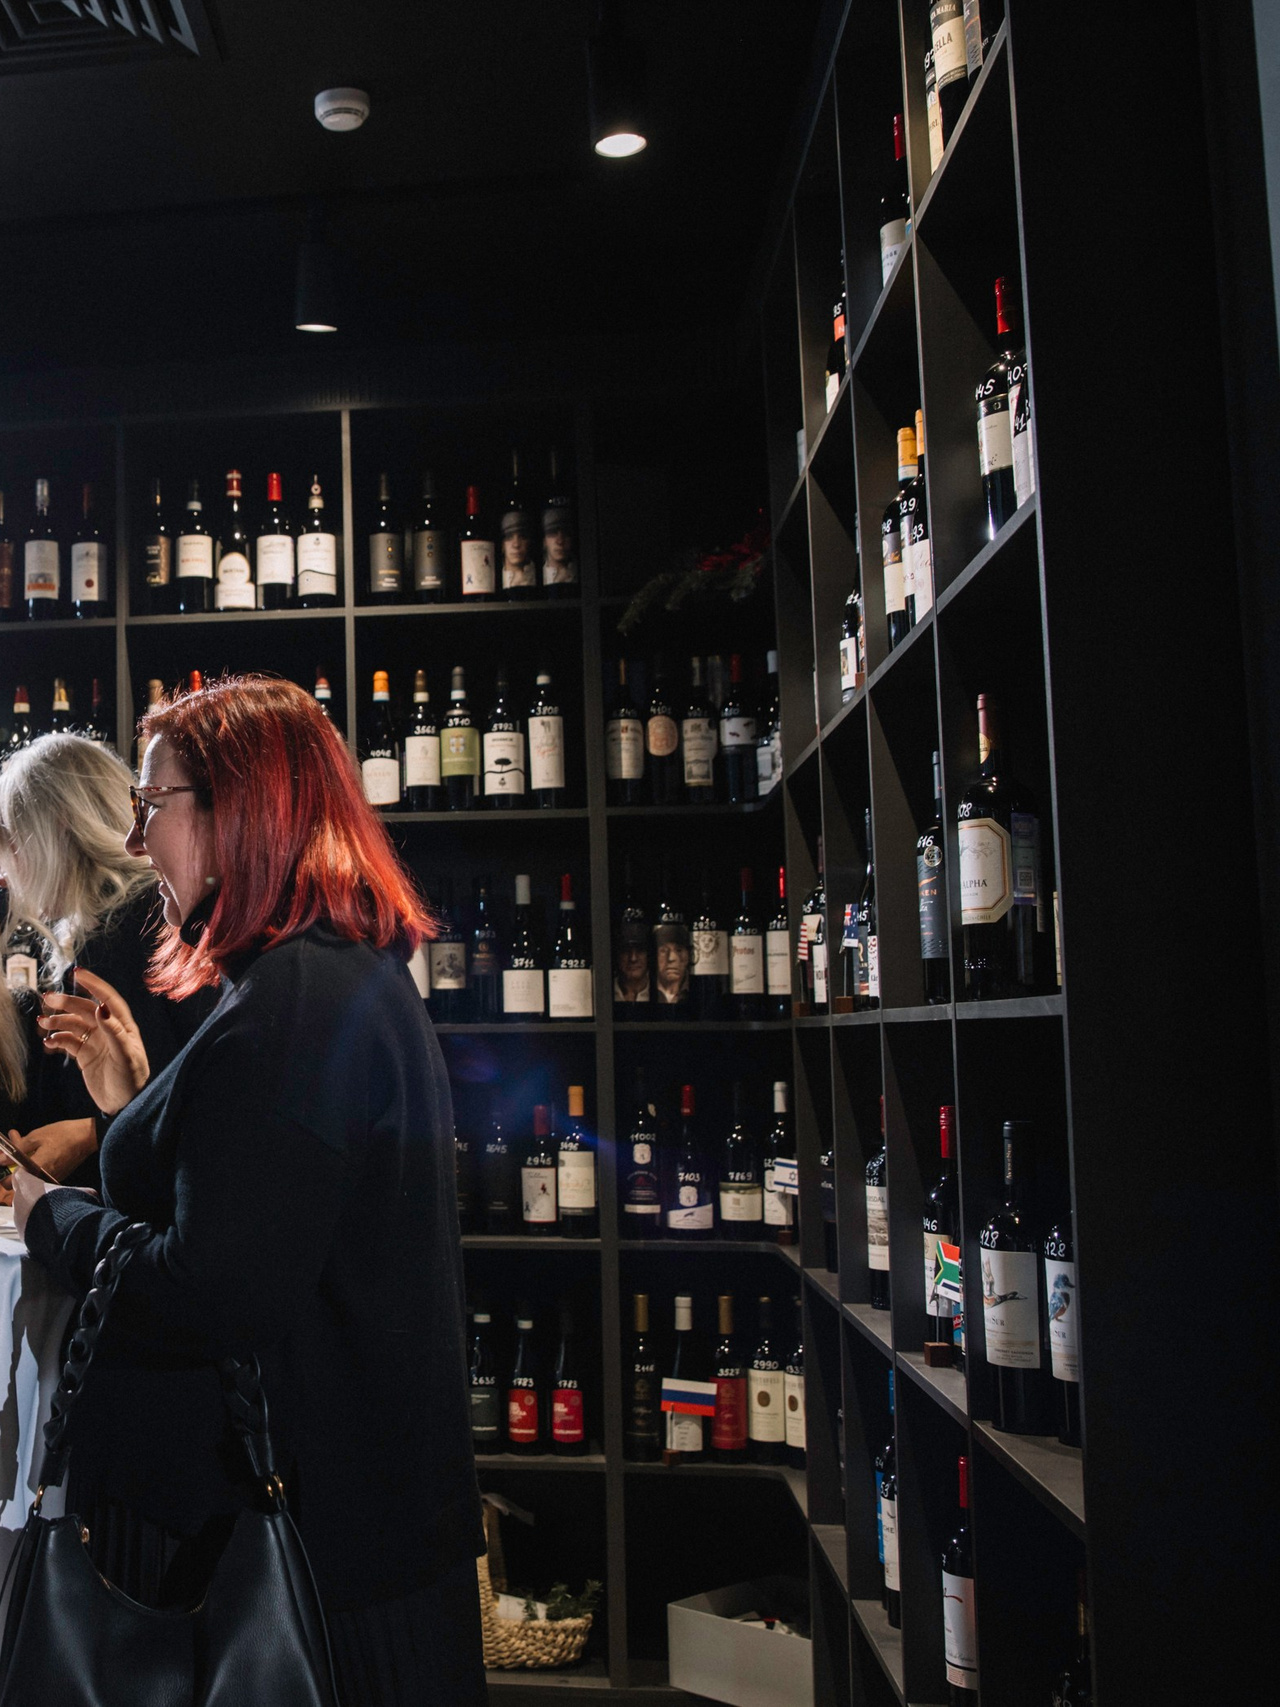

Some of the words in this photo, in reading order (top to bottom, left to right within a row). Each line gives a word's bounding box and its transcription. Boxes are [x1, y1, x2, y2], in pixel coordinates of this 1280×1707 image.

[448, 717, 471, 727] 3710
[958, 802, 973, 818] 08
[962, 879, 988, 889] ALPHA
[512, 958, 535, 968] 3711
[560, 959, 586, 968] 2925
[678, 1172, 701, 1182] 7103
[728, 1172, 752, 1181] 7869
[753, 1360, 778, 1370] 2990
[717, 1368, 740, 1377] 3527
[472, 1376, 496, 1385] 2635
[513, 1377, 534, 1387] 1783
[557, 1380, 578, 1389] 1783
